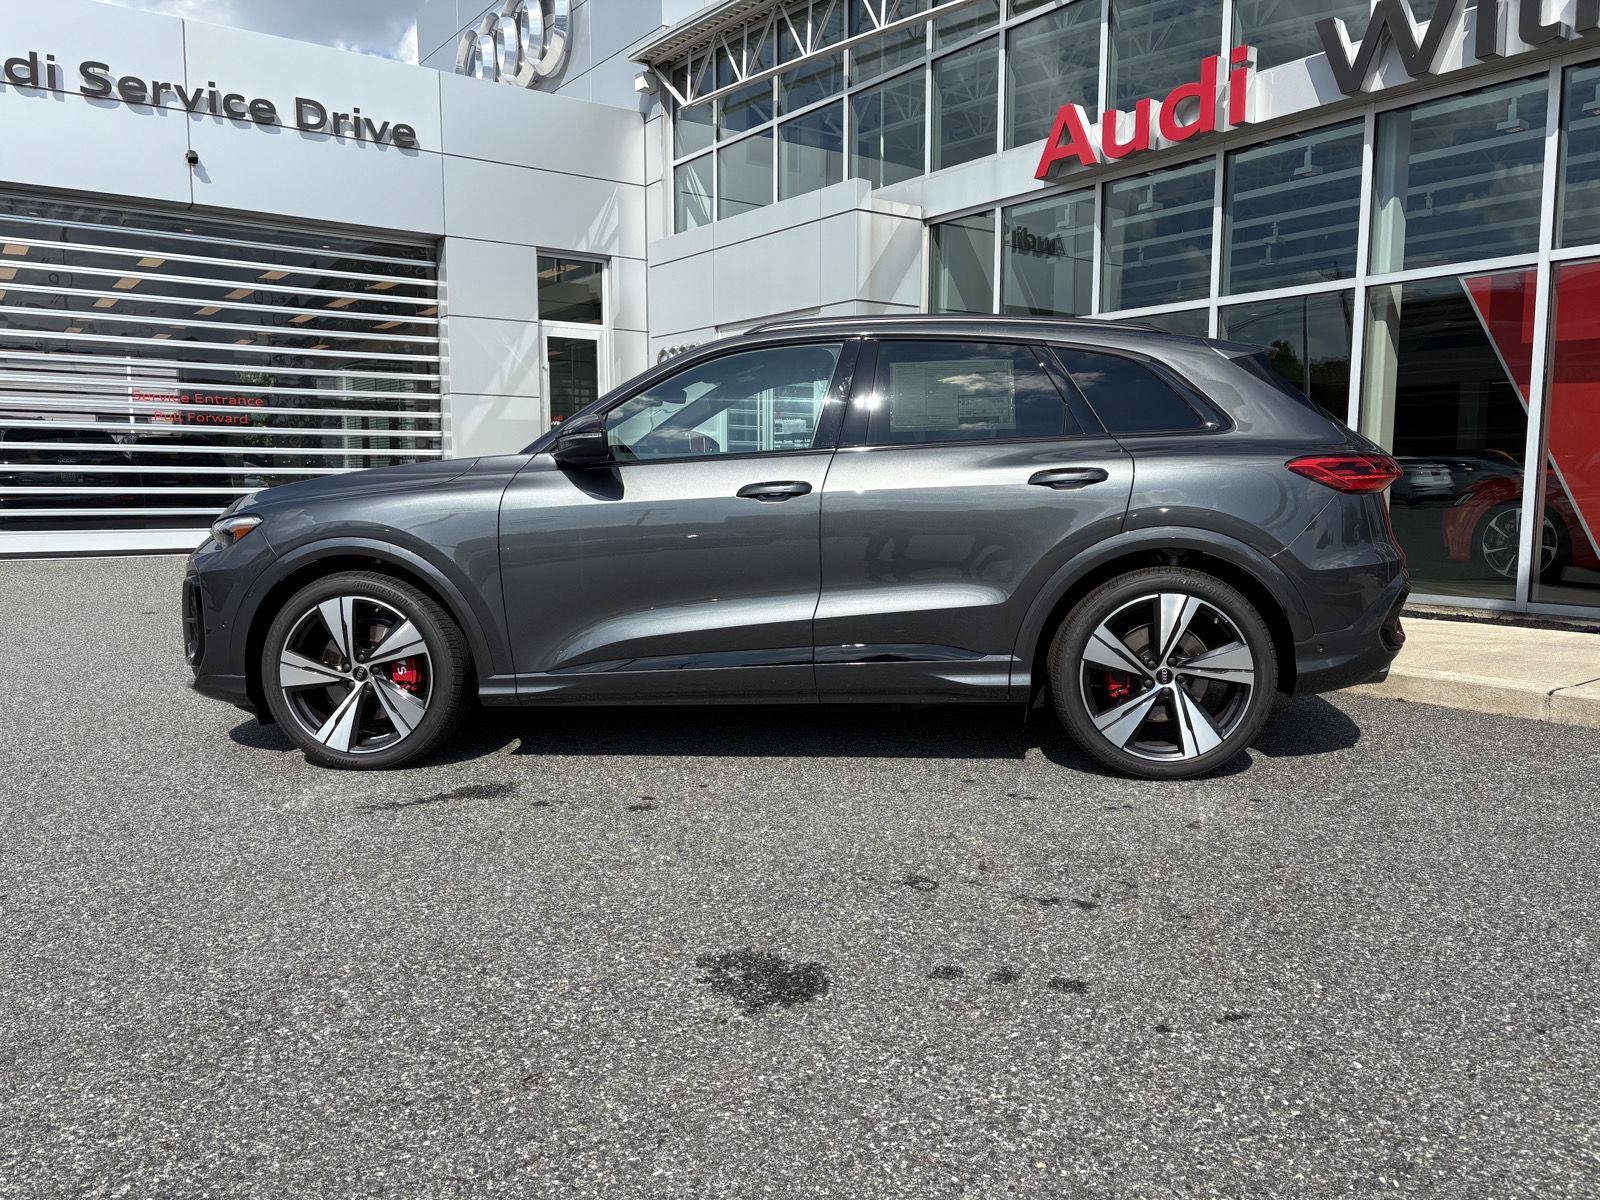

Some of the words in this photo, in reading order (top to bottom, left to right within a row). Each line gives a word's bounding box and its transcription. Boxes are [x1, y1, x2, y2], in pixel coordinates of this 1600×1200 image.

[79, 60, 277, 125] Service
[295, 96, 417, 148] Drive
[1033, 44, 1250, 179] Audi
[131, 390, 189, 404] Service
[194, 393, 264, 406] Entrance
[187, 411, 249, 424] Forward
